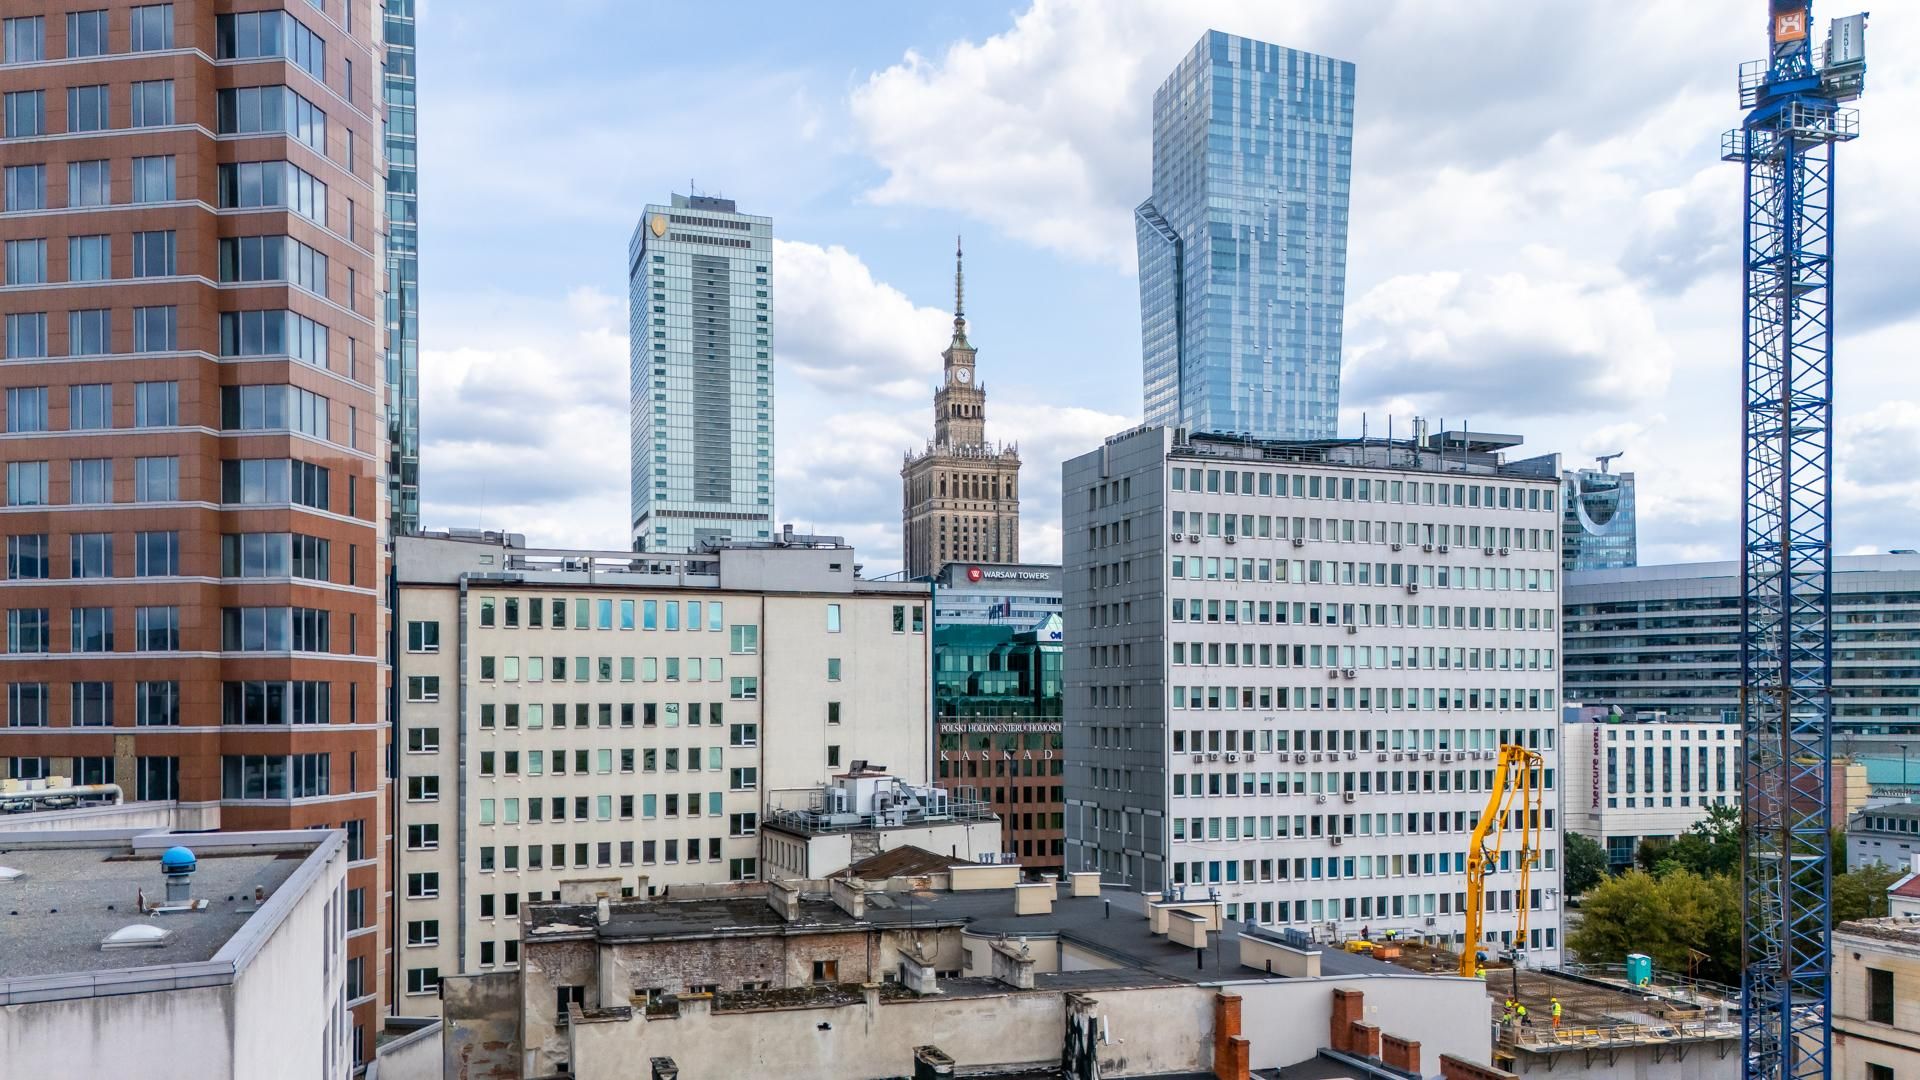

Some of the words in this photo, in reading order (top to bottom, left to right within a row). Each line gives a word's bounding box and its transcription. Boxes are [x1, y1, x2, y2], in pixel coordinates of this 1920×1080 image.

[983, 571, 1017, 579] WARSAW
[1018, 571, 1049, 580] TOWERS
[941, 724, 967, 733] POLSKI
[968, 724, 1001, 732] HOLDING
